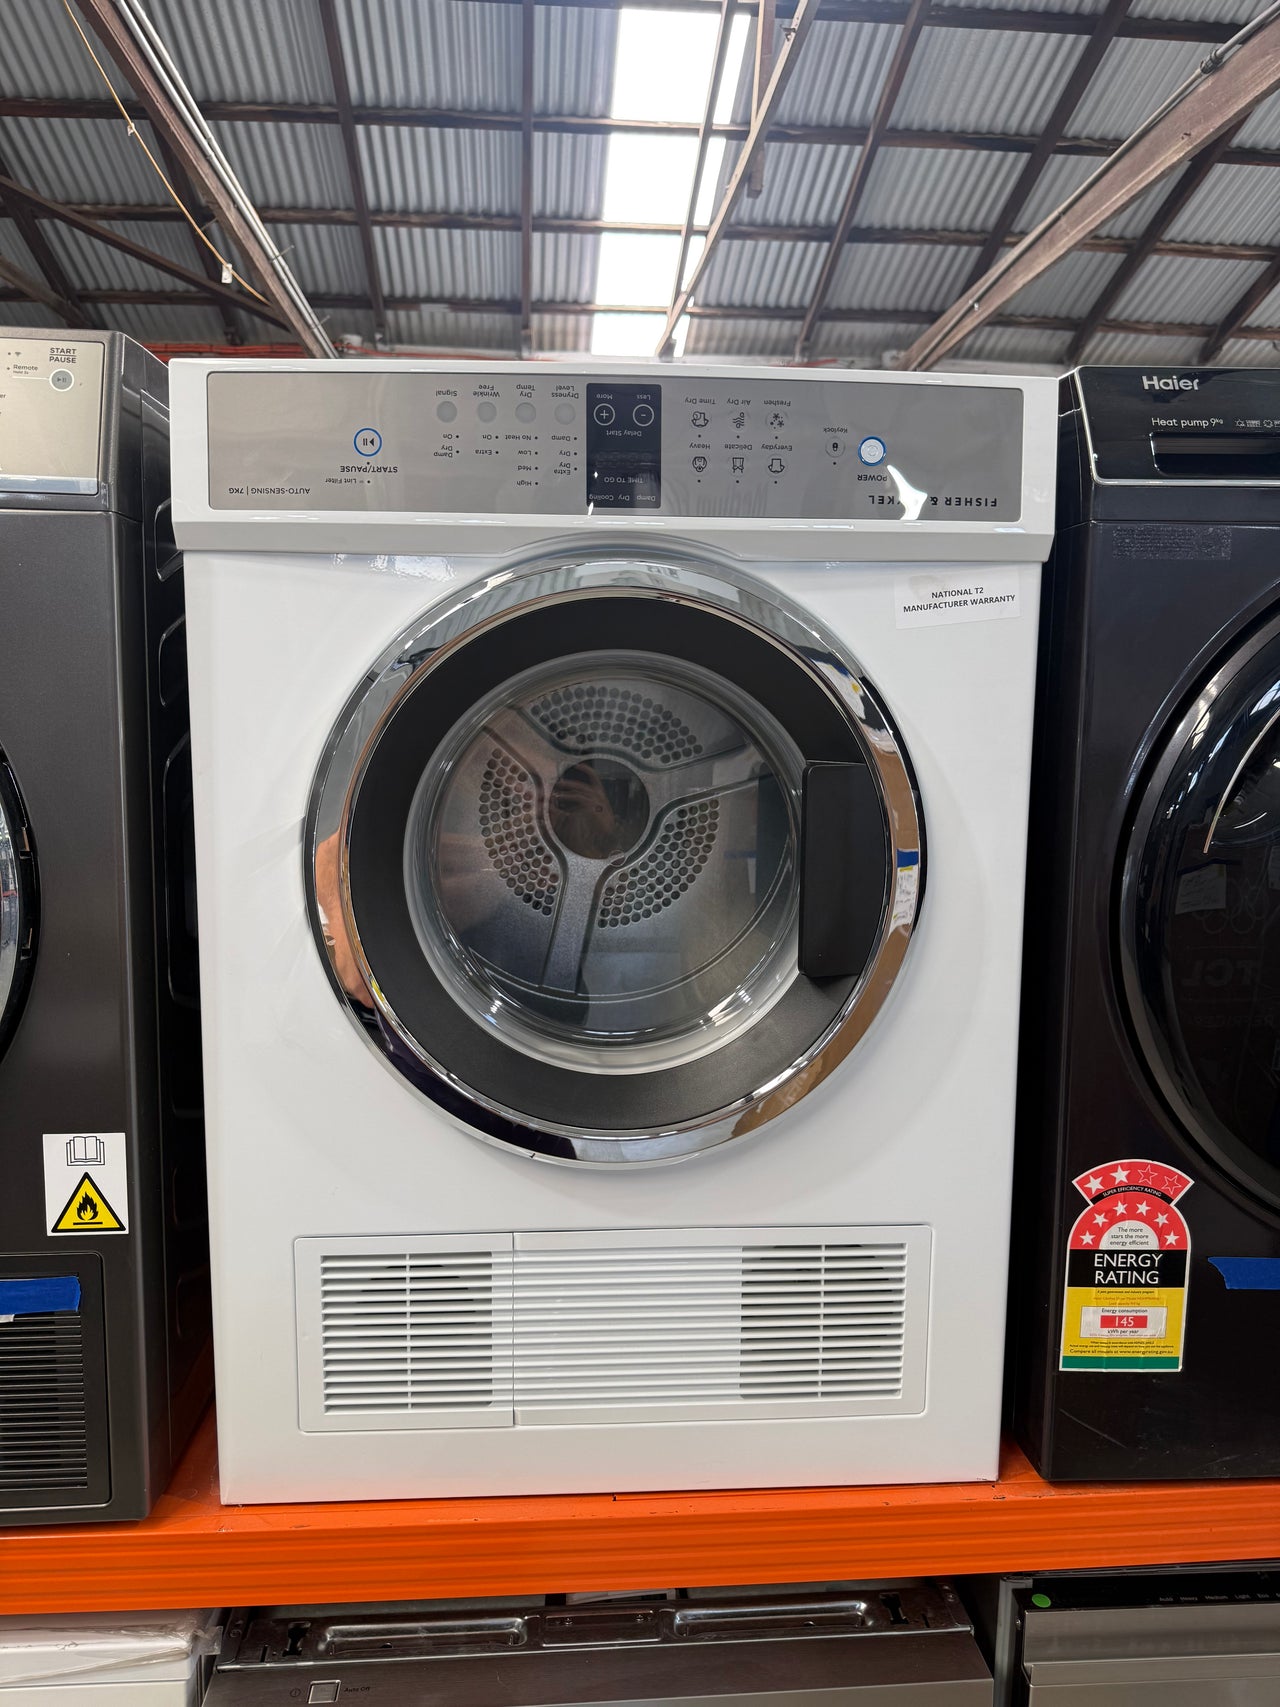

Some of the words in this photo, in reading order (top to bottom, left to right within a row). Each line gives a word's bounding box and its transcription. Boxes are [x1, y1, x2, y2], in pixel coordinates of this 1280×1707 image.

[1142, 376, 1199, 390] Haier
[1152, 418, 1178, 426] Heat
[1180, 419, 1209, 428] pump
[340, 465, 398, 473] START/PAUSE
[930, 496, 938, 506] &
[944, 496, 998, 506] FISHER
[932, 588, 972, 598] NATIONAL
[903, 600, 968, 612] MANUFACTURER
[970, 594, 1016, 606] WARRANTY
[1102, 1188, 1117, 1197] SUPER
[1144, 1188, 1162, 1196] RATING
[1094, 1254, 1163, 1268] ENERGY
[1095, 1270, 1159, 1284] RATING
[1115, 1316, 1134, 1326] 145
